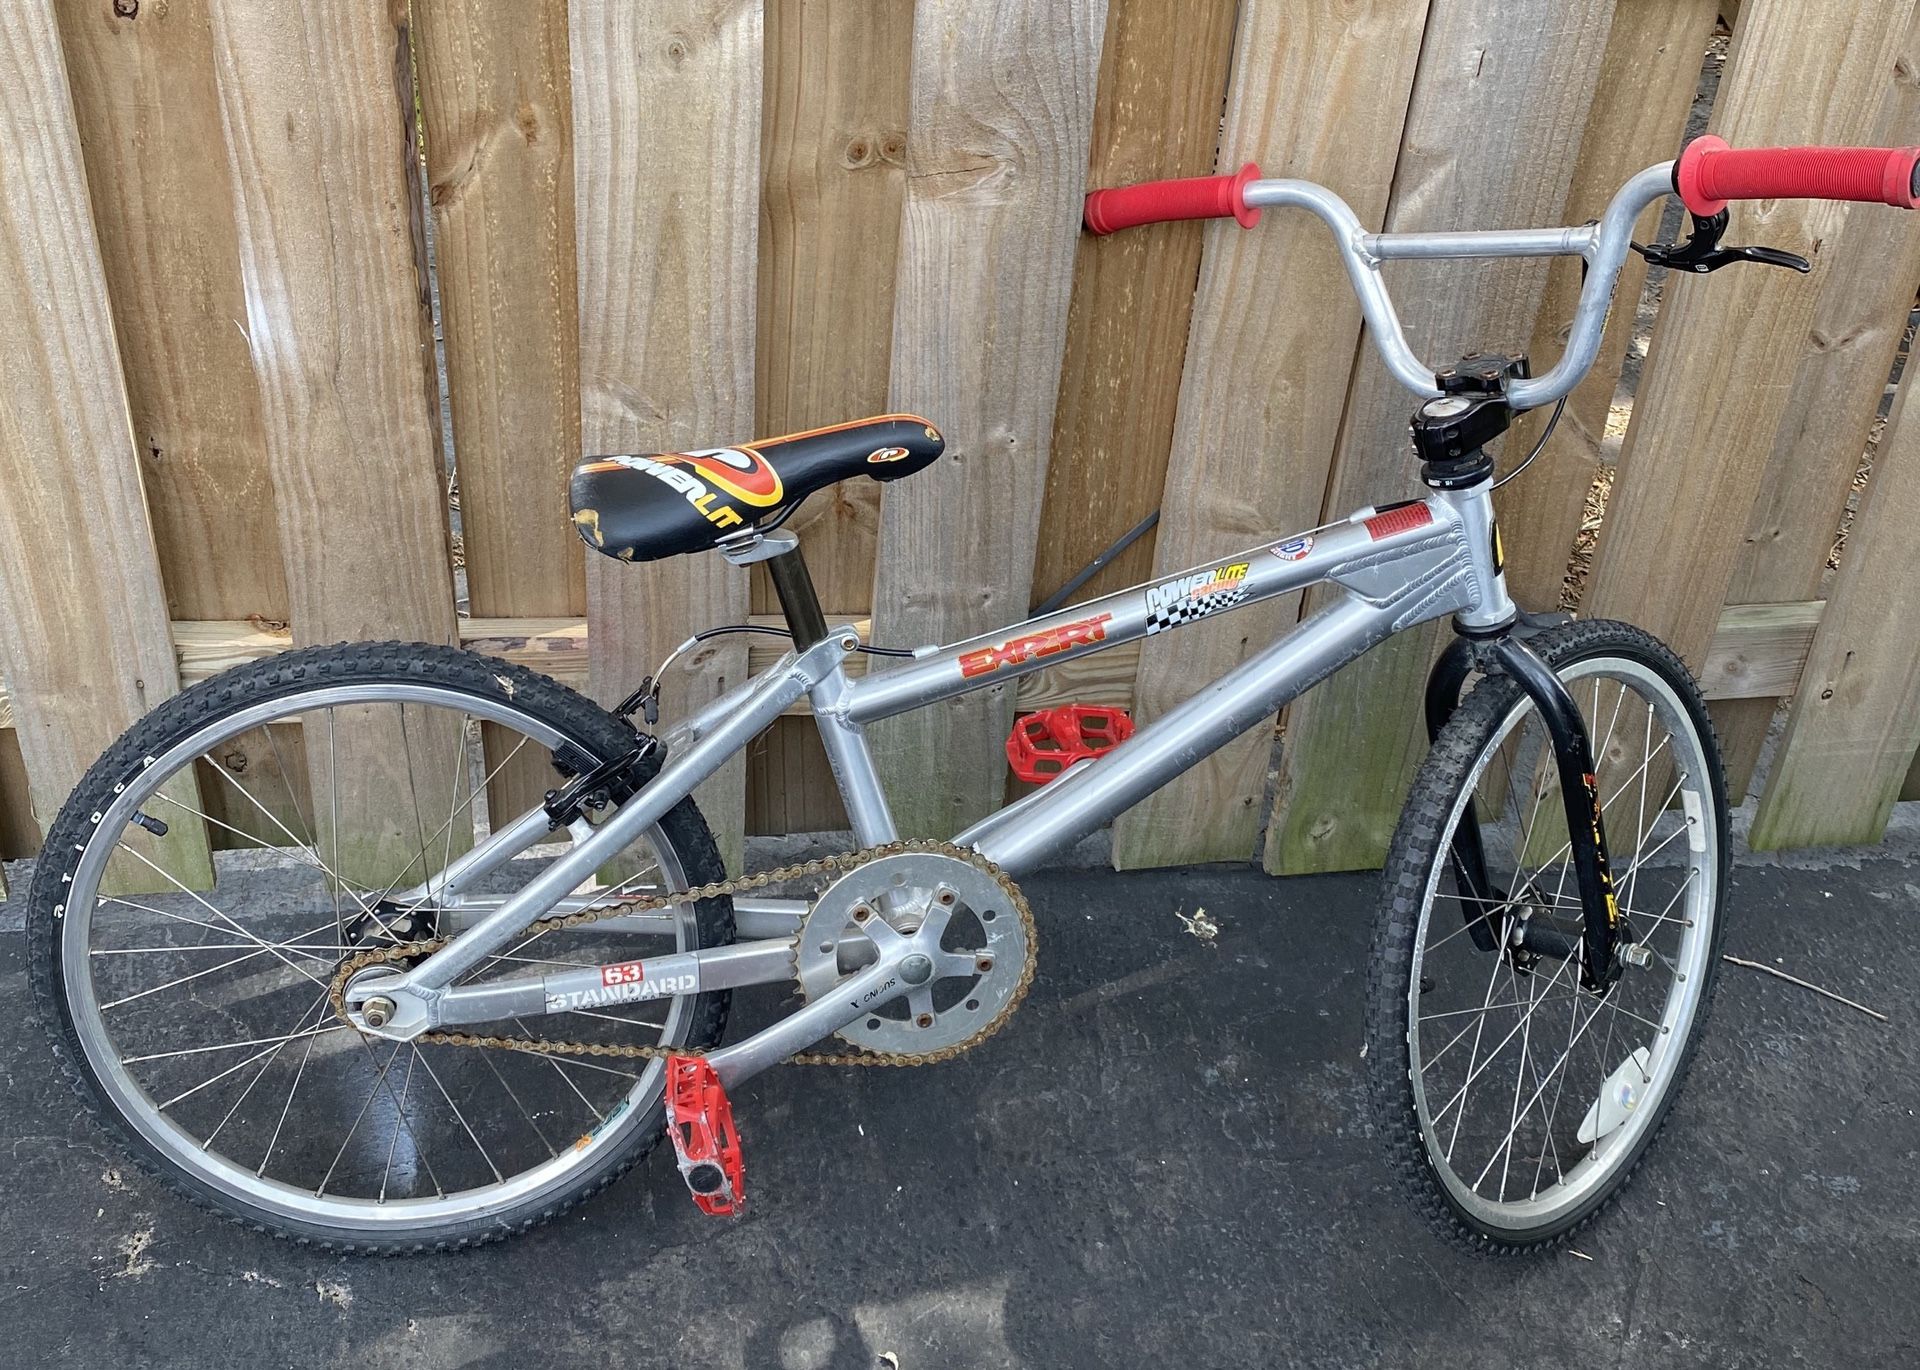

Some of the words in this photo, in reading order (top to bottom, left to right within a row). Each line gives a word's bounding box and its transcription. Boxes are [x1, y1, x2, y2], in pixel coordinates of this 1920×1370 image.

[1146, 563, 1250, 615] POWERLITE
[958, 612, 1113, 680] EXPERT
[549, 975, 697, 1009] STANDARD
[605, 965, 641, 985] 63
